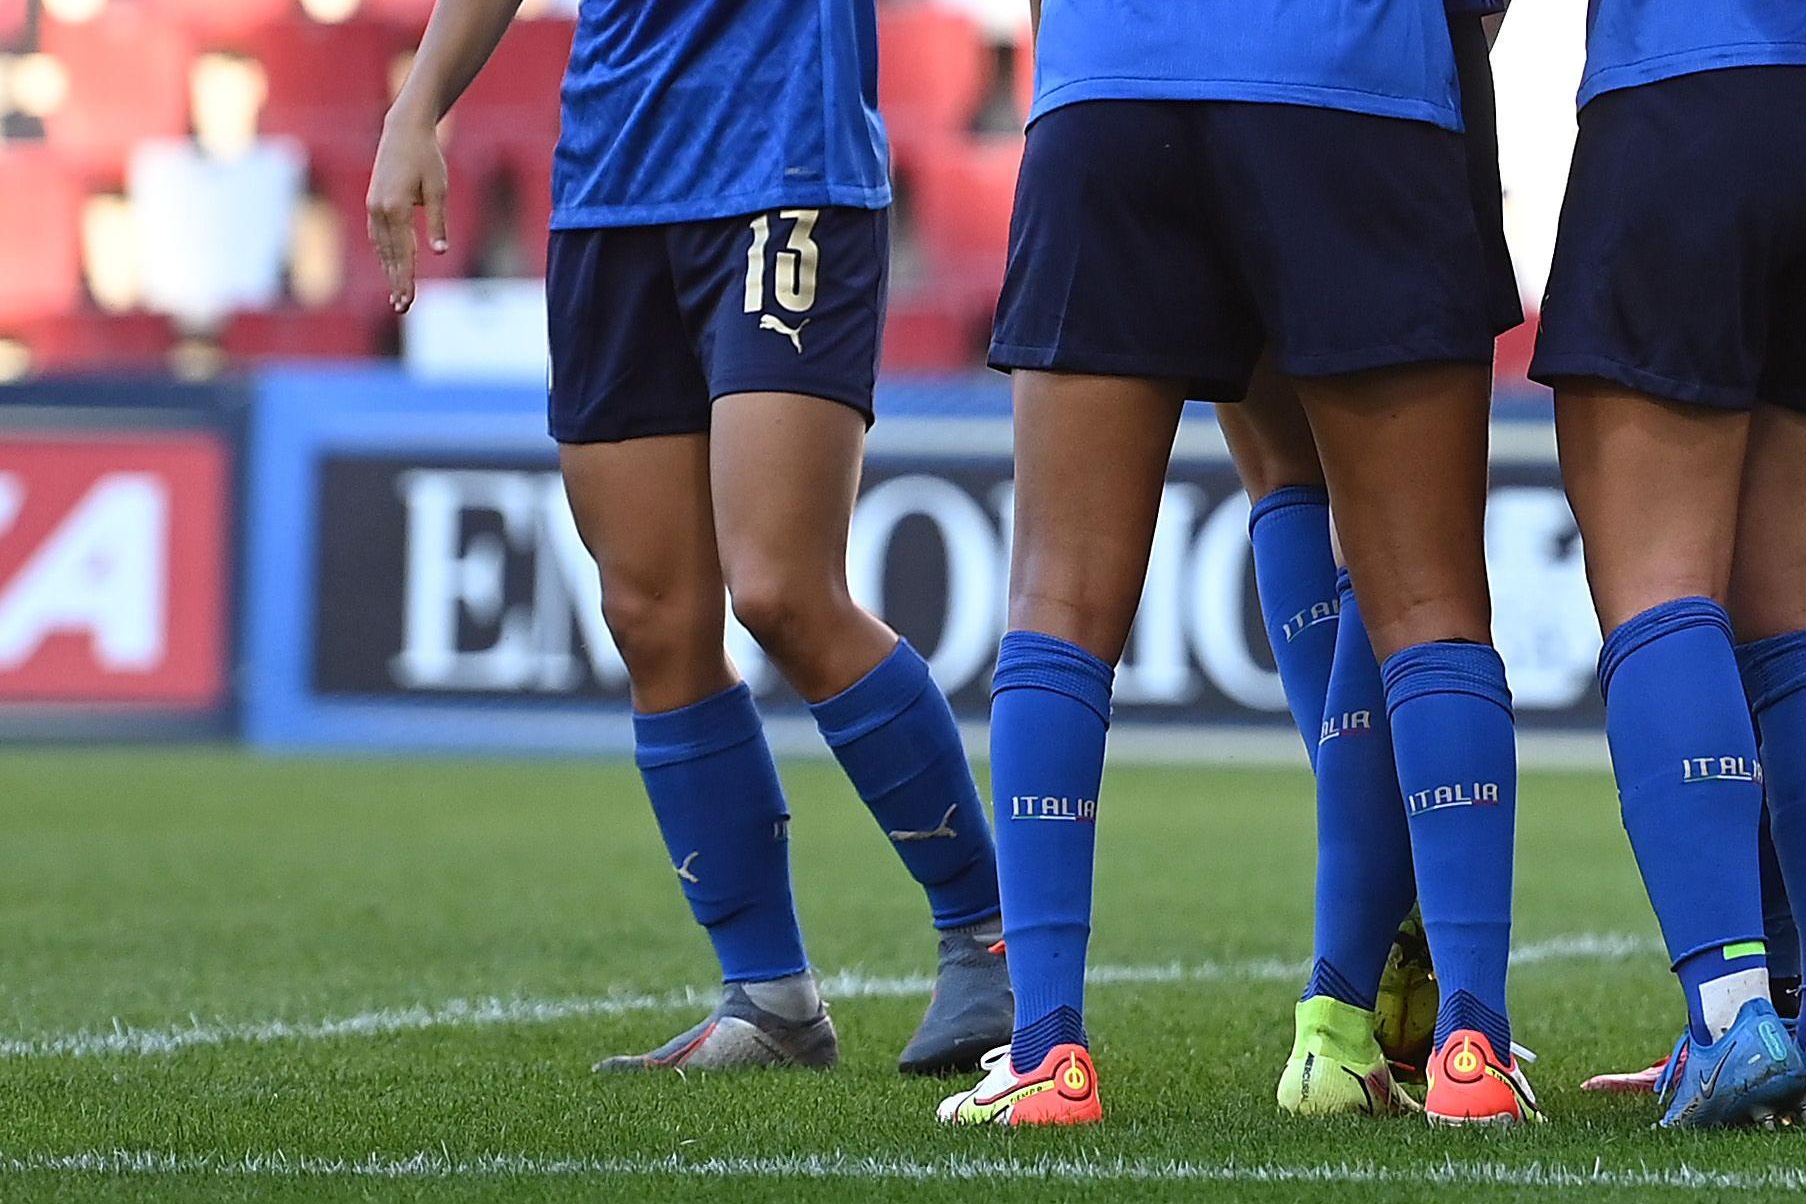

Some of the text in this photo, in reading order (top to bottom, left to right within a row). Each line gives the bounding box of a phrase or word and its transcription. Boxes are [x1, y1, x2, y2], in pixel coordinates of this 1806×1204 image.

[743, 208, 819, 313] 13
[1011, 796, 1096, 819] ITALIA
[1408, 782, 1498, 813] ITALIA
